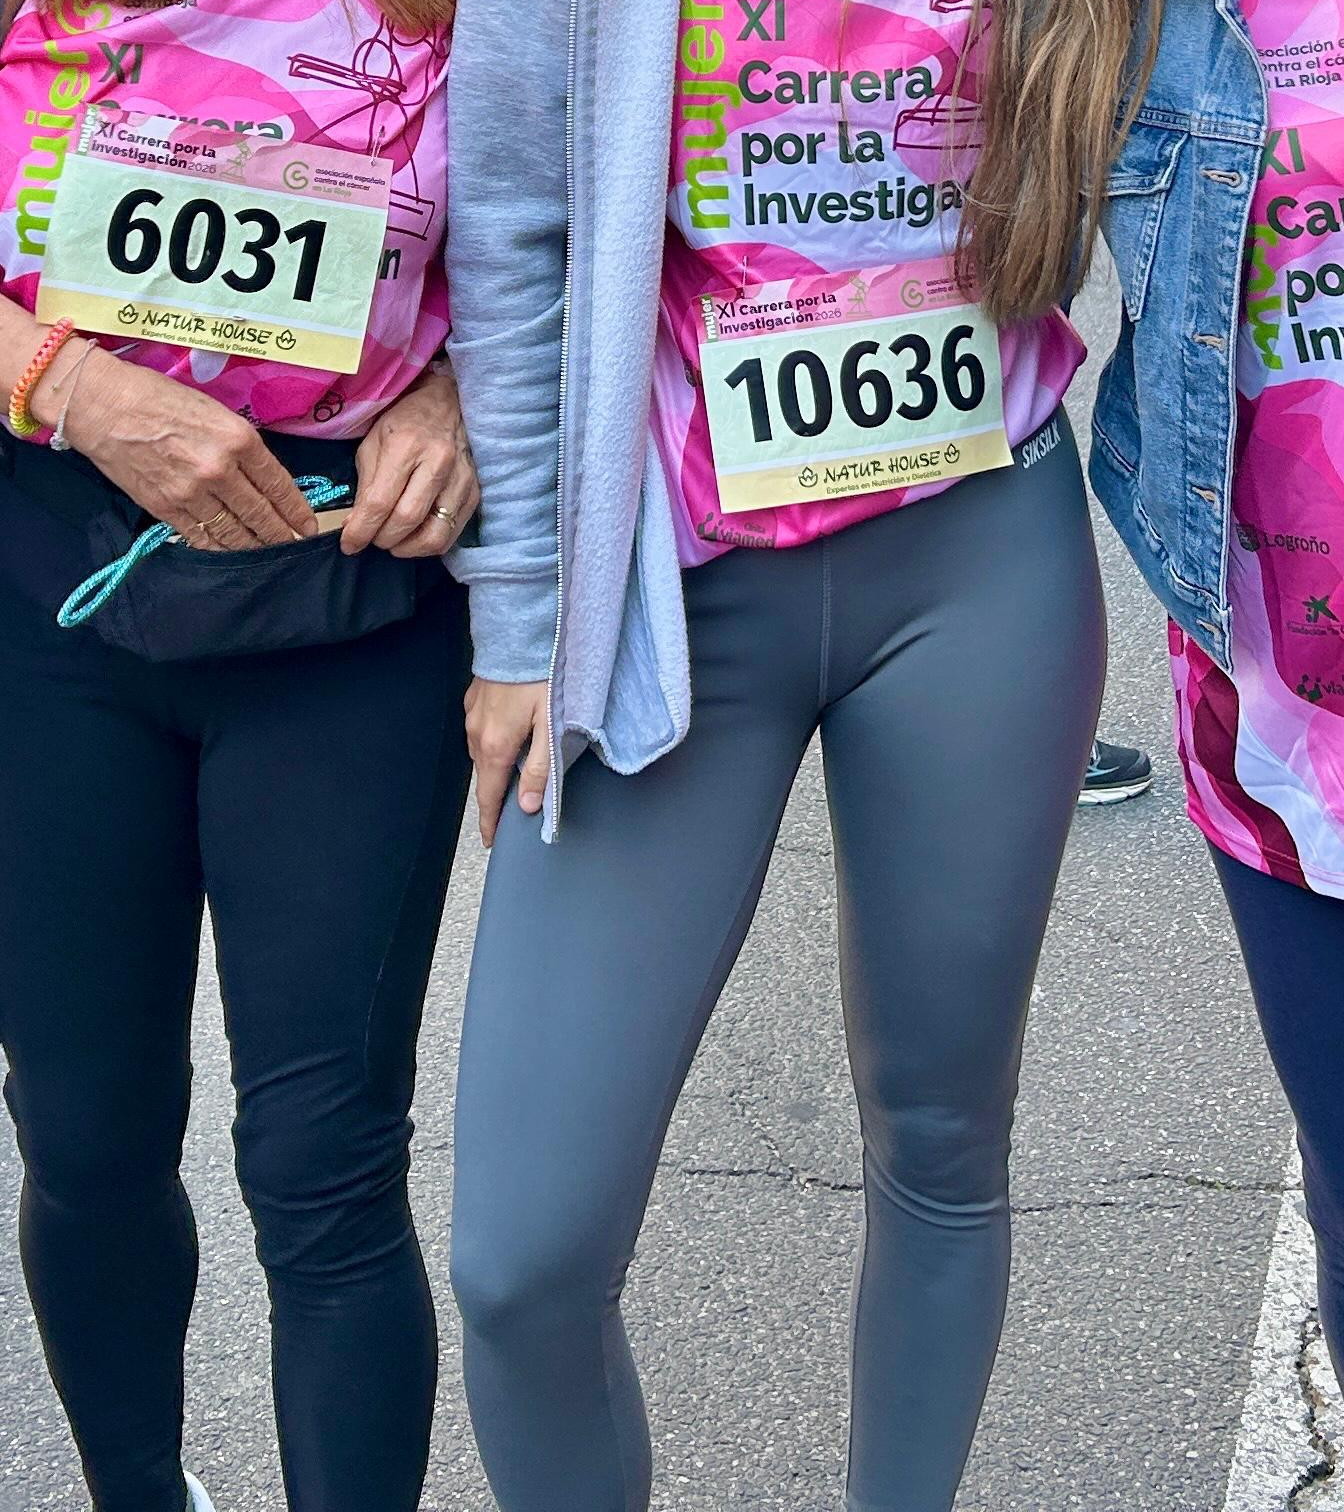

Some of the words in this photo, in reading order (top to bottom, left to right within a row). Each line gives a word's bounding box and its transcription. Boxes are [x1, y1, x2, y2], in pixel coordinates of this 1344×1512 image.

[98, 42, 144, 84] XI
[1257, 40, 1334, 57] sociación
[1306, 57, 1320, 69] el
[738, 61, 936, 104] Carrera
[1276, 76, 1295, 88] La
[1300, 71, 1342, 86] Rioja
[94, 121, 115, 138] XI
[118, 129, 171, 150] Carrera
[173, 142, 199, 156] por
[202, 145, 216, 158] la
[743, 130, 826, 176] por
[838, 120, 884, 164] la
[187, 162, 217, 175] 2026
[745, 179, 962, 228] Investiga
[107, 188, 327, 302] 6031
[716, 302, 735, 320] XI
[740, 300, 793, 316] Carrera
[796, 296, 819, 311] por
[822, 292, 836, 304] la
[815, 308, 842, 321] 2026
[142, 309, 206, 332] NATUR
[210, 319, 273, 344] HOUSE
[724, 324, 985, 442] 10636
[1021, 420, 1061, 469] SIKSILK
[823, 460, 884, 484] NATUR
[889, 451, 941, 473] HOUSE
[826, 482, 860, 495] Expertos
[871, 475, 906, 488] Nutrición
[912, 469, 942, 481] Dietética
[1263, 531, 1330, 555] Logroño
